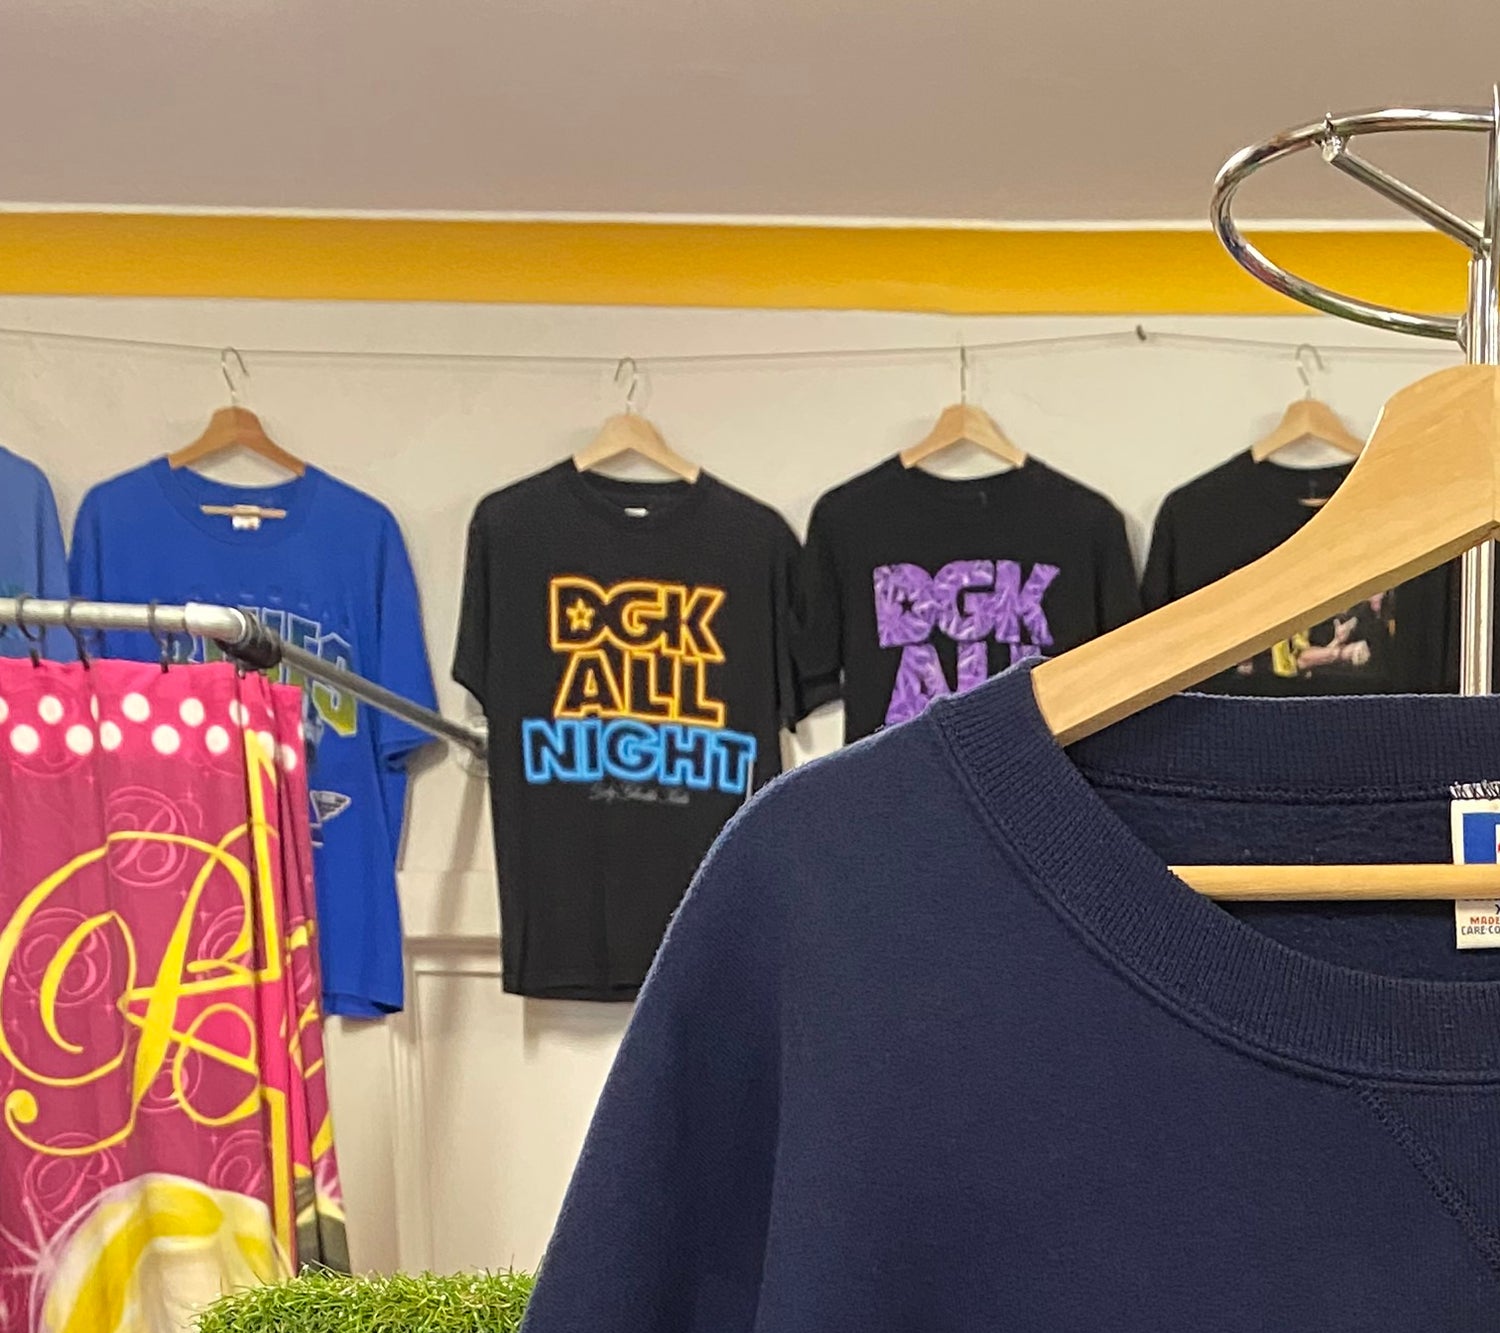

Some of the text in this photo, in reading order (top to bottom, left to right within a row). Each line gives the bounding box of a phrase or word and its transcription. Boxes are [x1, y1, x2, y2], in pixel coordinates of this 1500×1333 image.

[549, 574, 726, 664] DGK
[873, 559, 1061, 649] DGK
[553, 648, 726, 729] ALL
[521, 717, 758, 796] NIGHT
[1470, 916, 1500, 925] MADE
